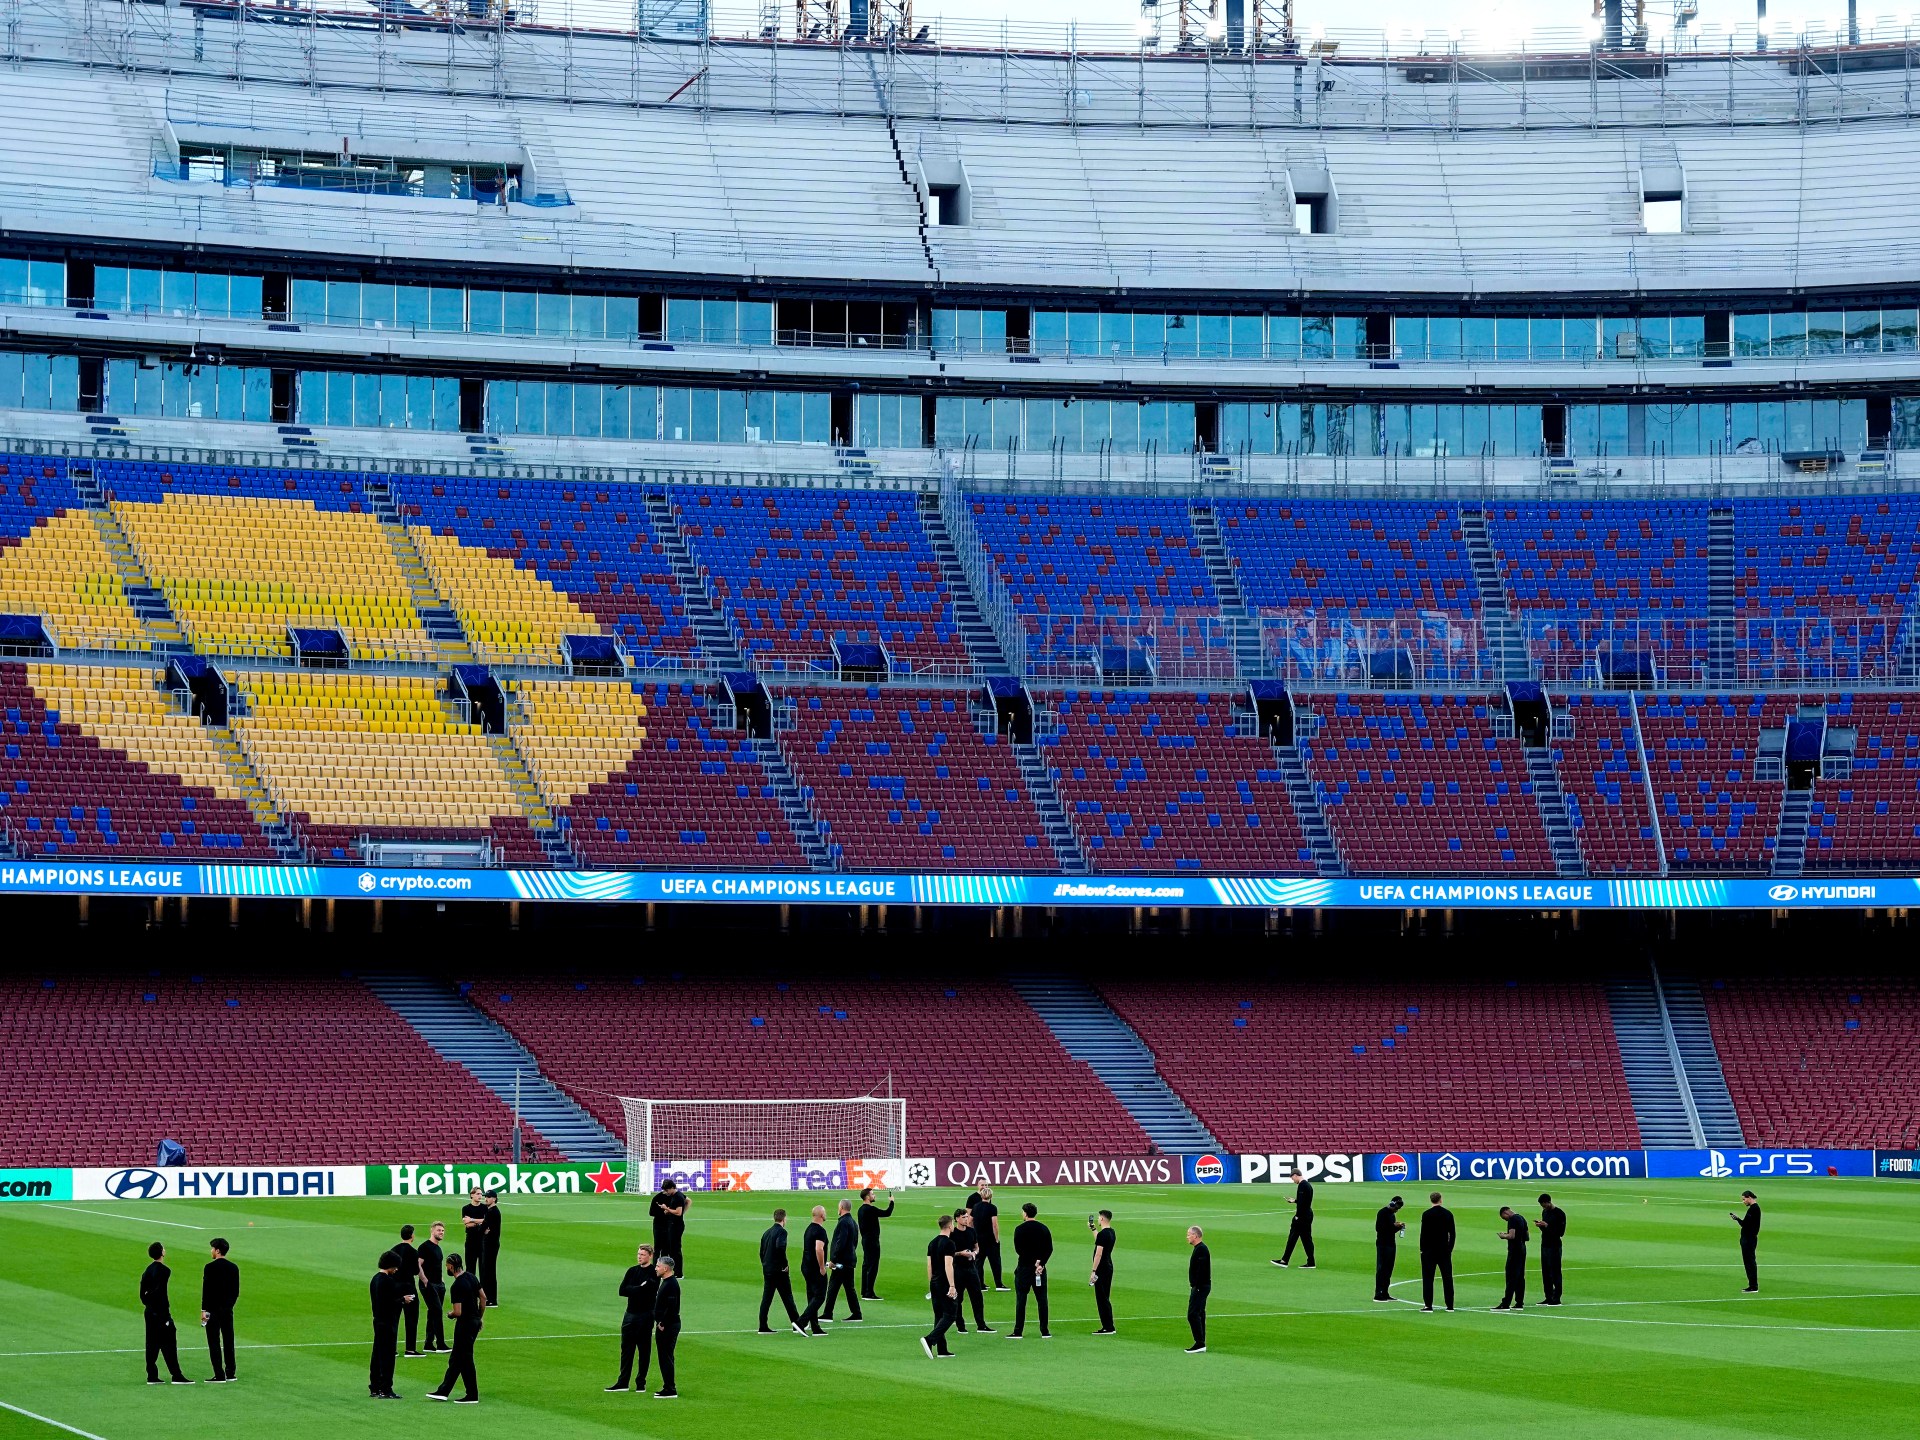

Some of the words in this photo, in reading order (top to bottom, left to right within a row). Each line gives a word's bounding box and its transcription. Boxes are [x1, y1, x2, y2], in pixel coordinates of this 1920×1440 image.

[2, 868, 104, 886] HAMPIONS
[109, 869, 183, 887] LEAGUE
[380, 875, 472, 891] crypto.com
[661, 879, 707, 894] UEFA
[711, 879, 821, 895] CHAMPIONS
[825, 881, 896, 896] LEAGUE
[1360, 885, 1405, 900] UEFA
[1410, 885, 1518, 900] CHAMPIONS
[1523, 886, 1593, 900] LEAGUE
[1801, 886, 1876, 899] HYUNDAI
[947, 1160, 1043, 1187] QATAR
[1055, 1159, 1171, 1184] AIRWAYS
[1196, 1166, 1222, 1175] PEPSI
[1240, 1154, 1364, 1184] PEPSI
[1382, 1164, 1406, 1173] PEPSI
[1470, 1153, 1630, 1180] crypto.com
[1738, 1154, 1814, 1174] PS5
[178, 1171, 335, 1196] HYUNDAI
[388, 1164, 582, 1196] Heineken
[653, 1159, 752, 1192] FedEx
[790, 1159, 889, 1190] FedEx
